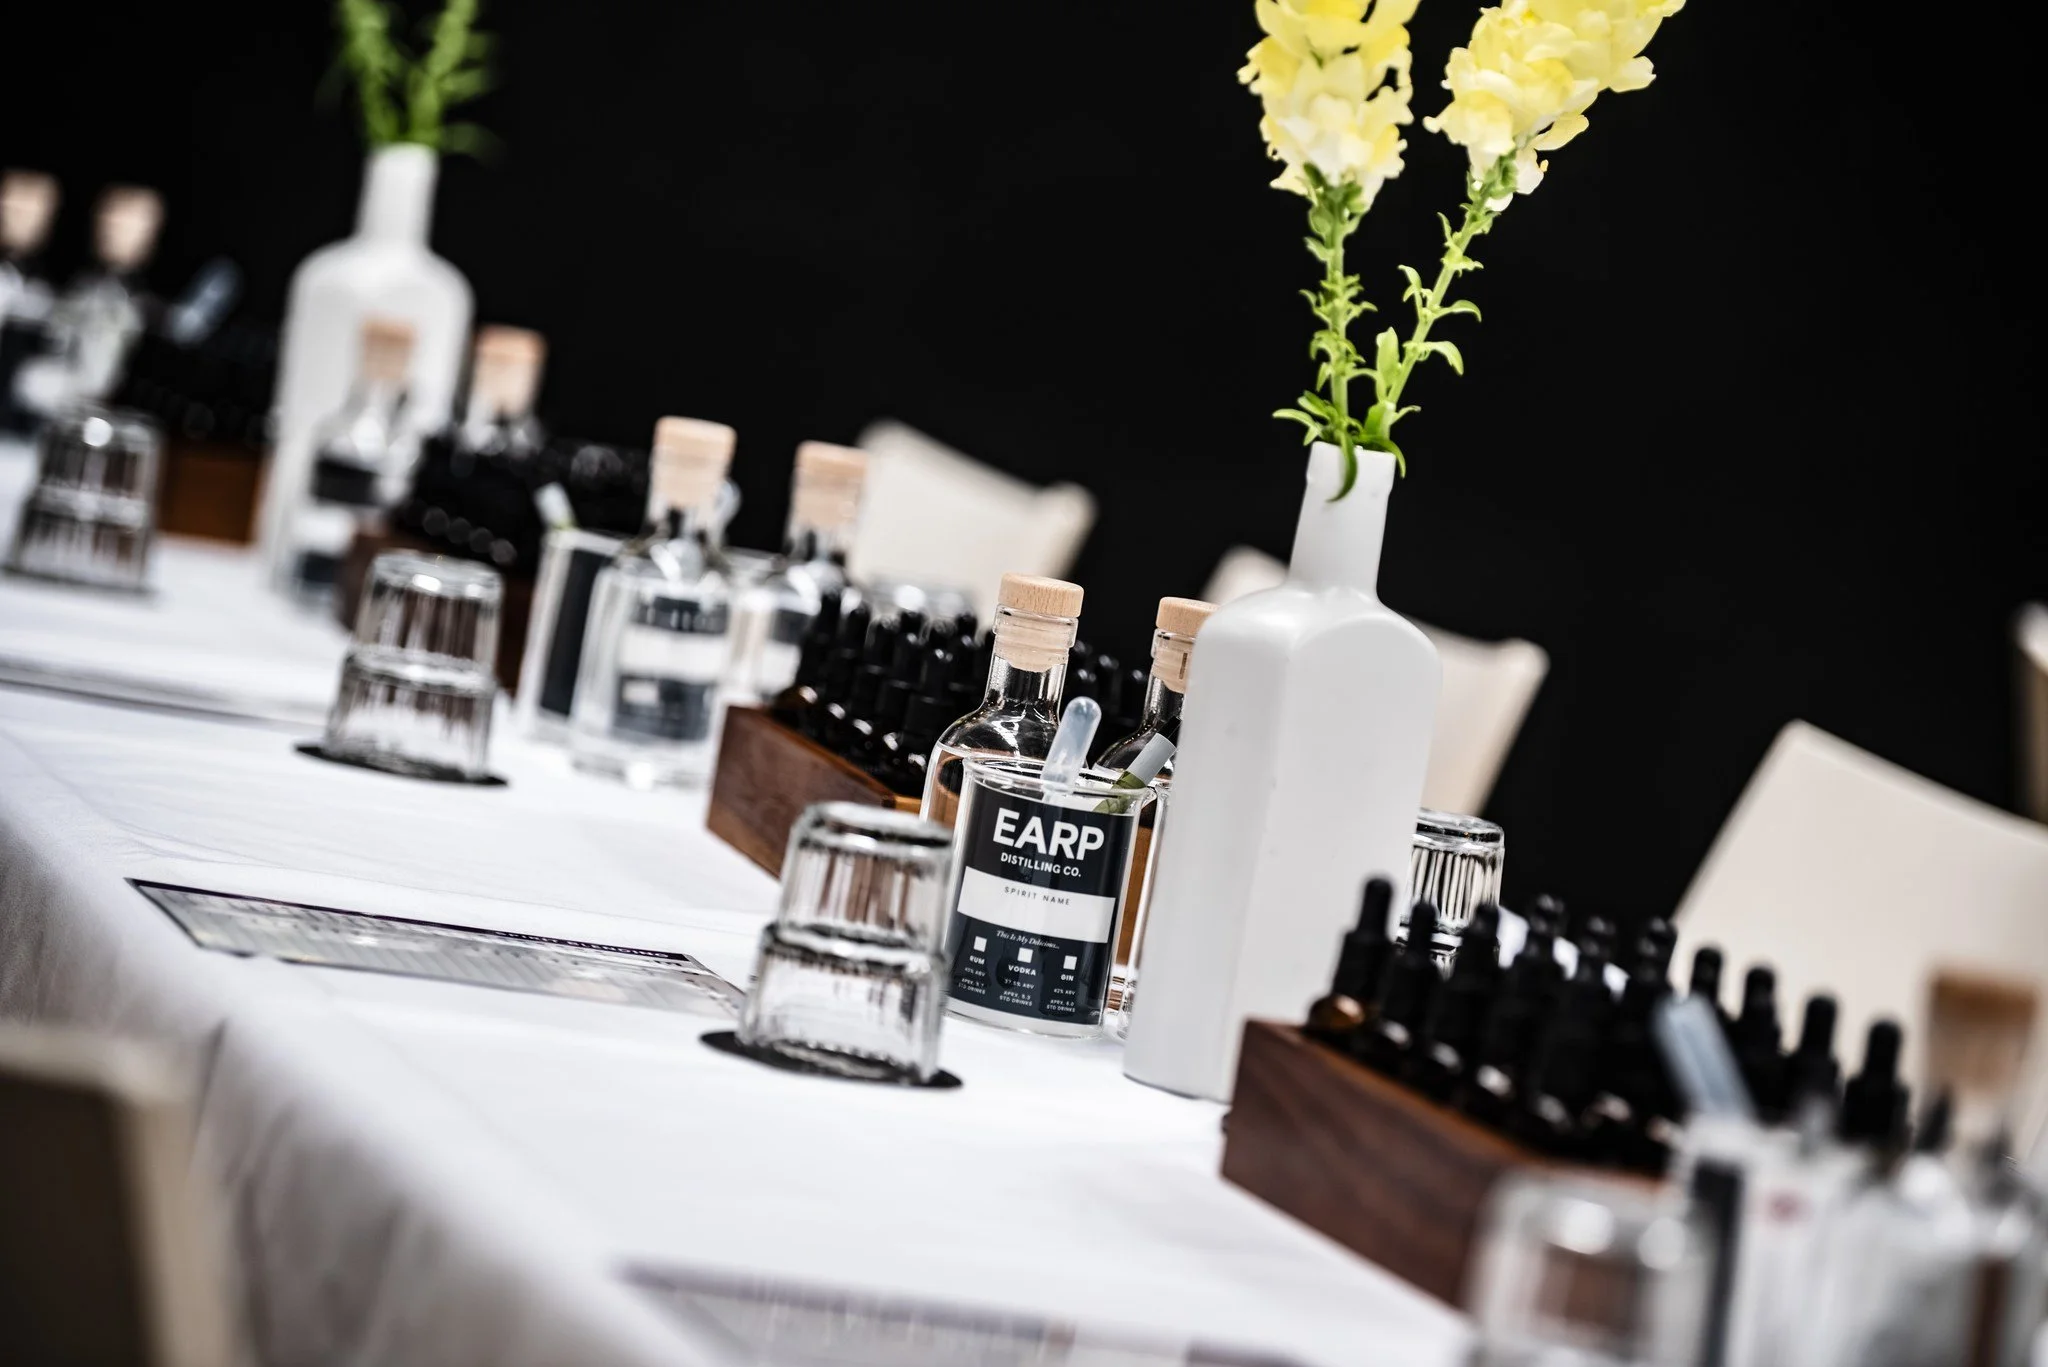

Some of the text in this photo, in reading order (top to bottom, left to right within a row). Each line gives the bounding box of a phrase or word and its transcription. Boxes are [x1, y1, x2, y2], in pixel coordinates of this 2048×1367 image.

[992, 807, 1105, 861] EARP
[1000, 852, 1082, 877] DISTILLING CO.
[1004, 886, 1071, 905] SPIRIT NAME
[996, 930, 1009, 939] This
[1018, 935, 1029, 945] My
[969, 955, 985, 965] RUM
[1008, 964, 1037, 976] VODKA
[1060, 974, 1075, 982] GIN
[1023, 981, 1035, 990] ABV
